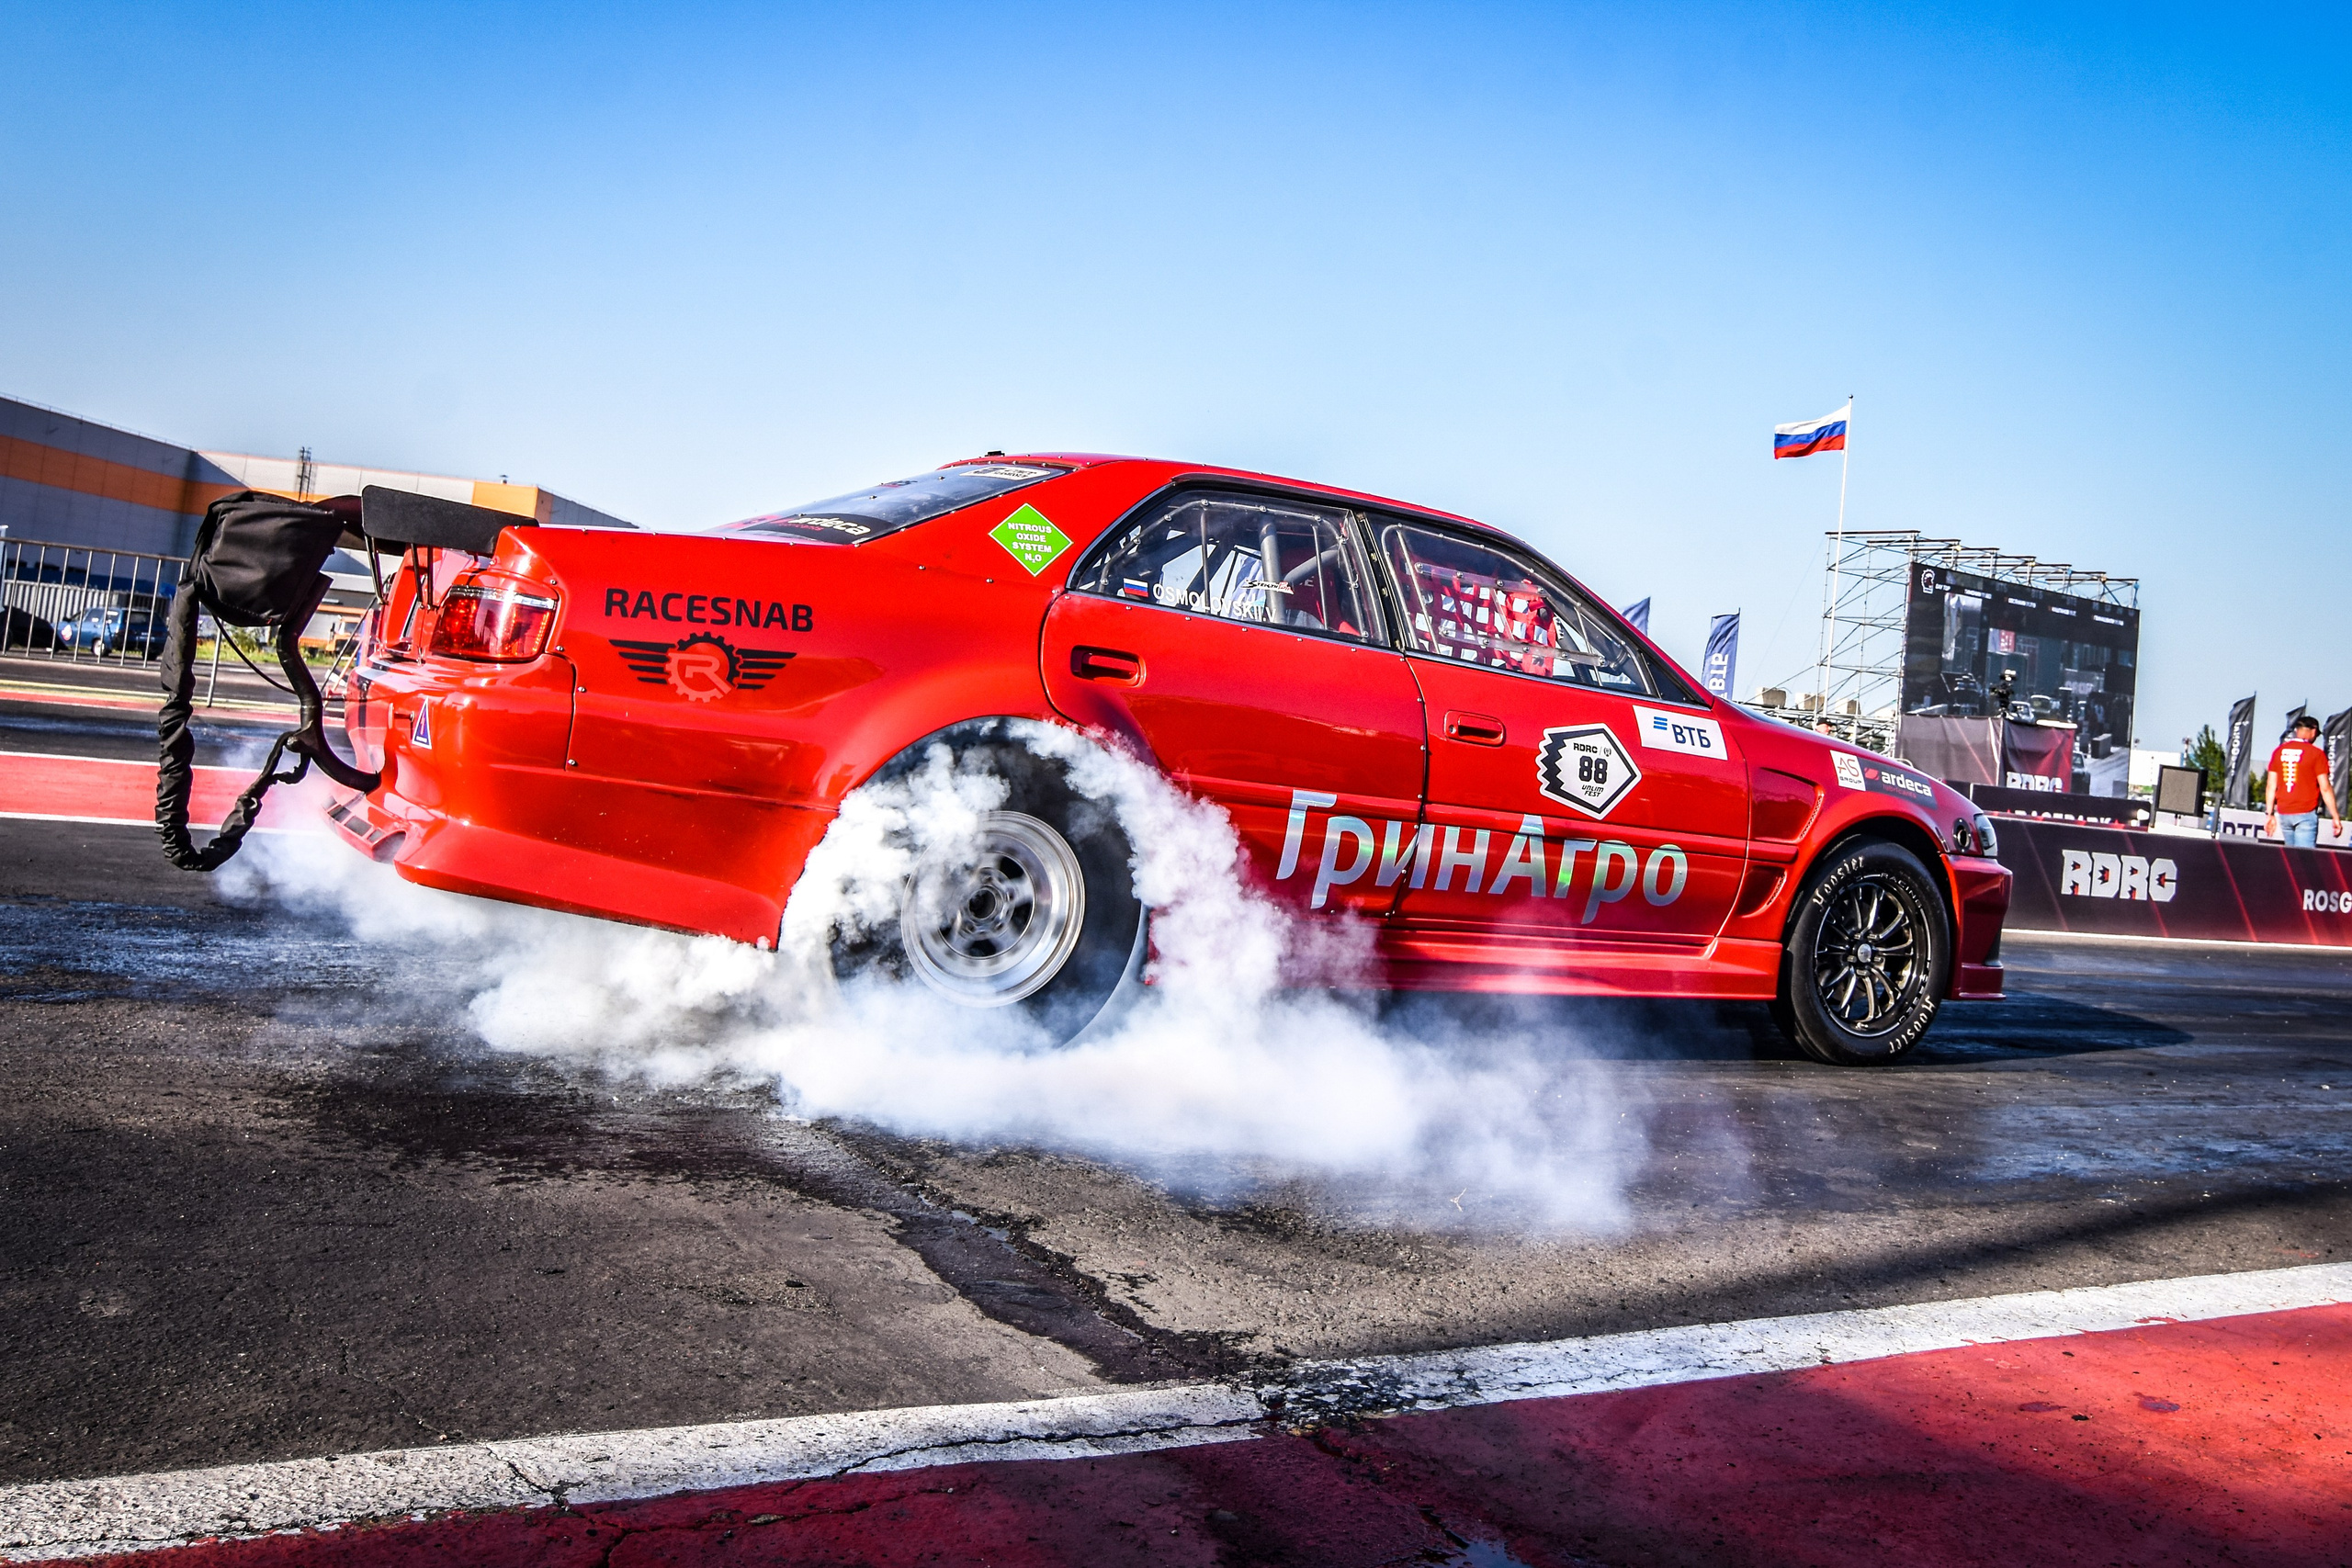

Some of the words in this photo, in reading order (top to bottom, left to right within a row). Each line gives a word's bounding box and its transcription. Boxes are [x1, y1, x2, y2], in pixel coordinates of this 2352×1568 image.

[1007, 522, 1052, 534] NITROUS
[1016, 532, 1046, 543] OXIDE
[1012, 541, 1053, 553] SYSTEM
[605, 588, 813, 632] RACESNAB
[1573, 742, 1598, 753] RDRC
[1671, 724, 1712, 749] ВТБ
[1578, 755, 1608, 784] 88
[1839, 775, 1862, 784] GROUP
[1881, 772, 1933, 797] ardeca
[1276, 789, 1689, 924] ГринАгро
[1813, 855, 1864, 910] Hoosier
[2061, 850, 2177, 902] RDRC
[1881, 873, 1922, 908] RACING
[2302, 889, 2352, 914] ROSG
[1889, 995, 1936, 1054] Hoosier
